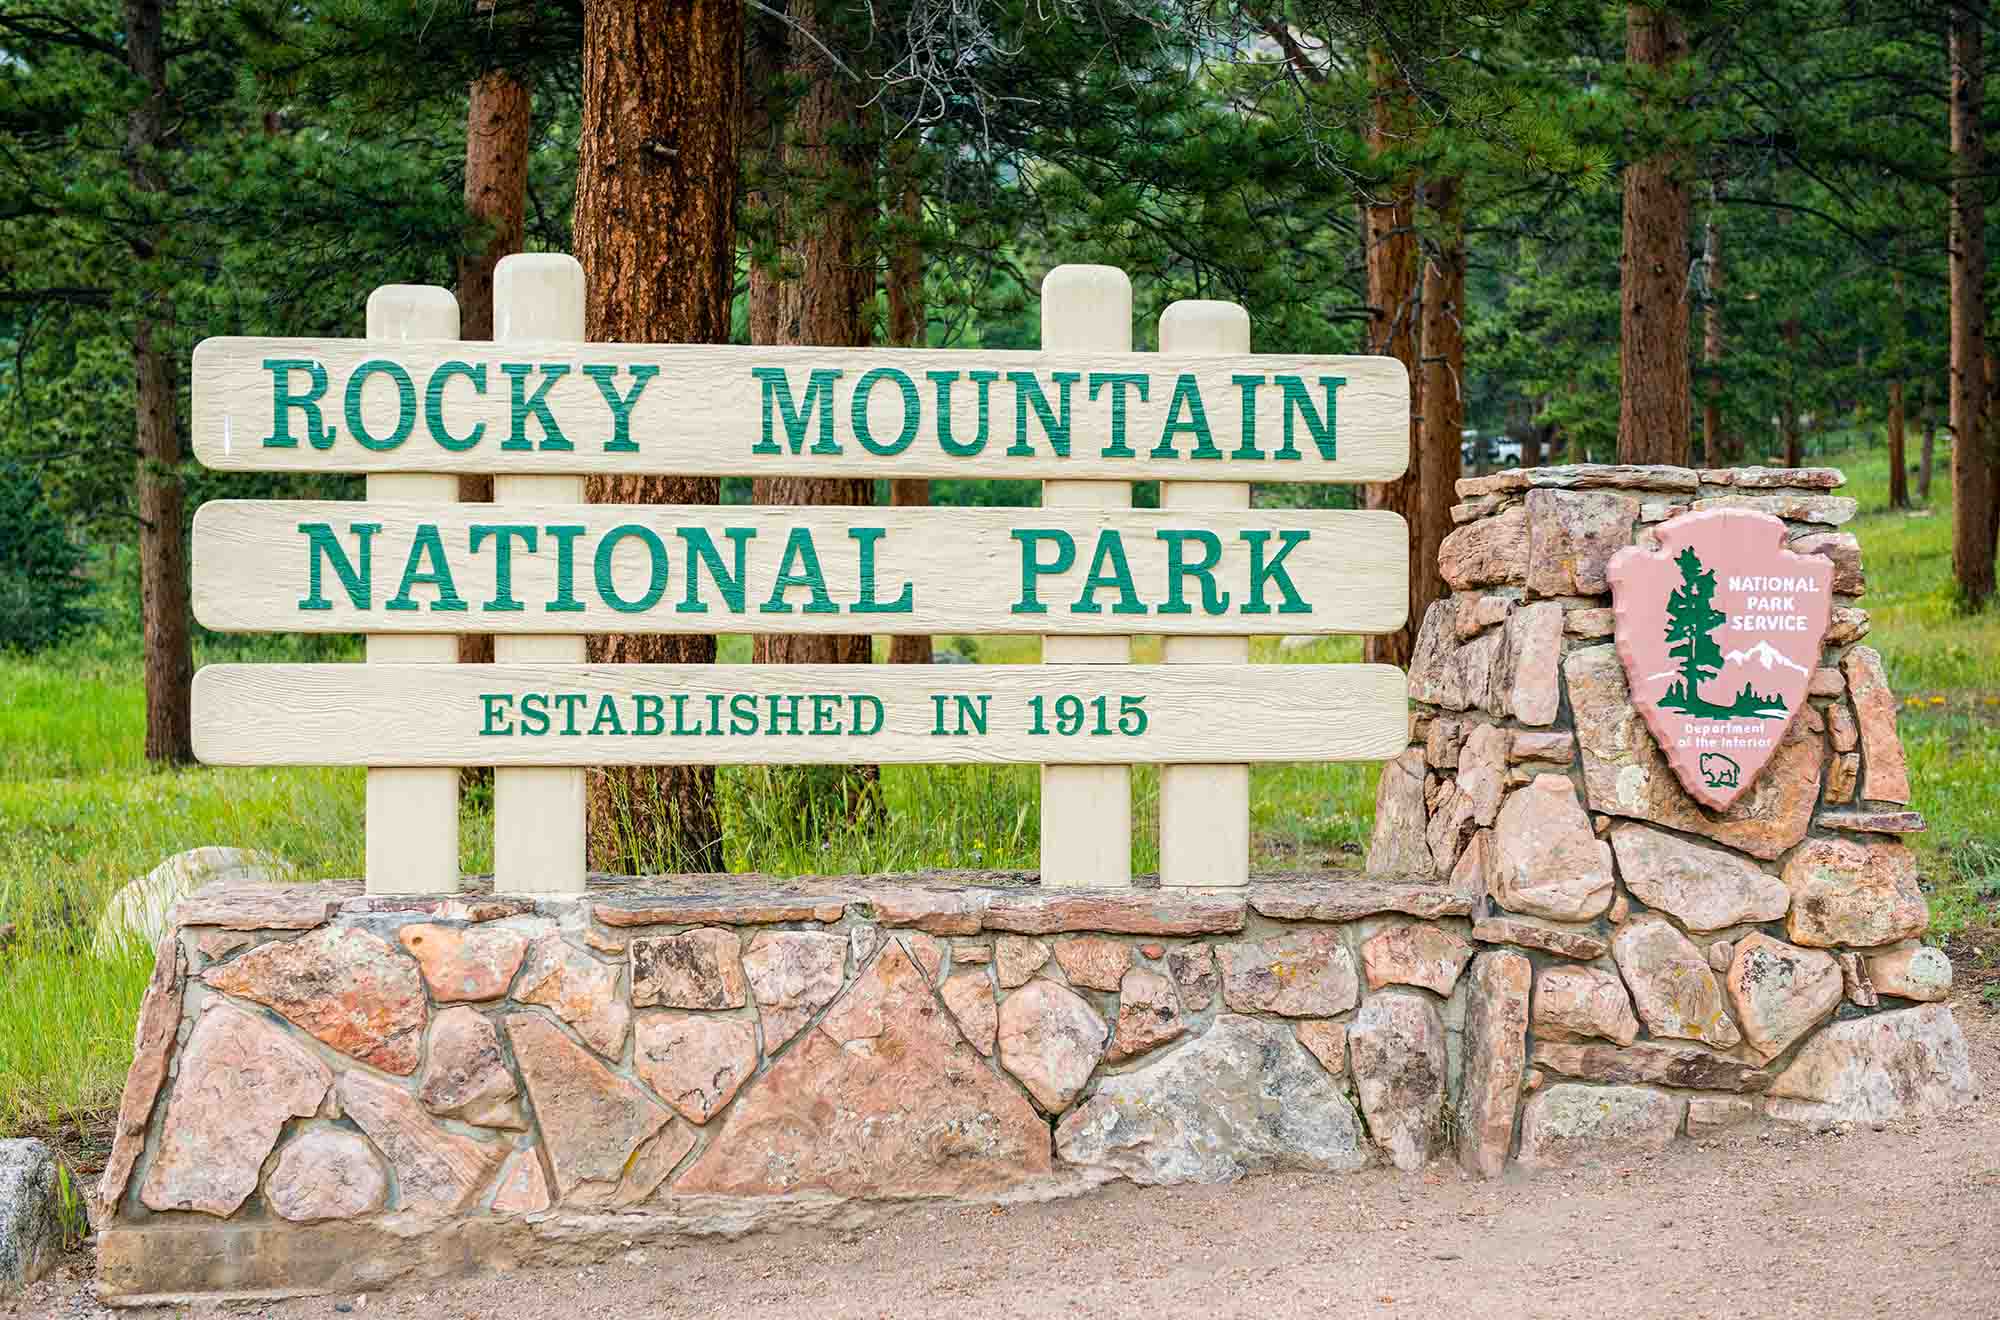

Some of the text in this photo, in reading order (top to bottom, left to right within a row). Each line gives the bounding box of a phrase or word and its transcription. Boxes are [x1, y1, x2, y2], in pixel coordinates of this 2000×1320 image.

[262, 359, 1348, 461] ROCKY MOUNTAIN
[297, 522, 1313, 615] NATIONAL PARK
[1728, 575, 1819, 592] NATIONAL
[1747, 596, 1794, 611] PARK
[1731, 615, 1809, 631] SERVICE
[479, 693, 1149, 737] ESTABLISHED IN 1915
[1685, 723, 1765, 736] Department
[1678, 736, 1772, 748] of the Interior
